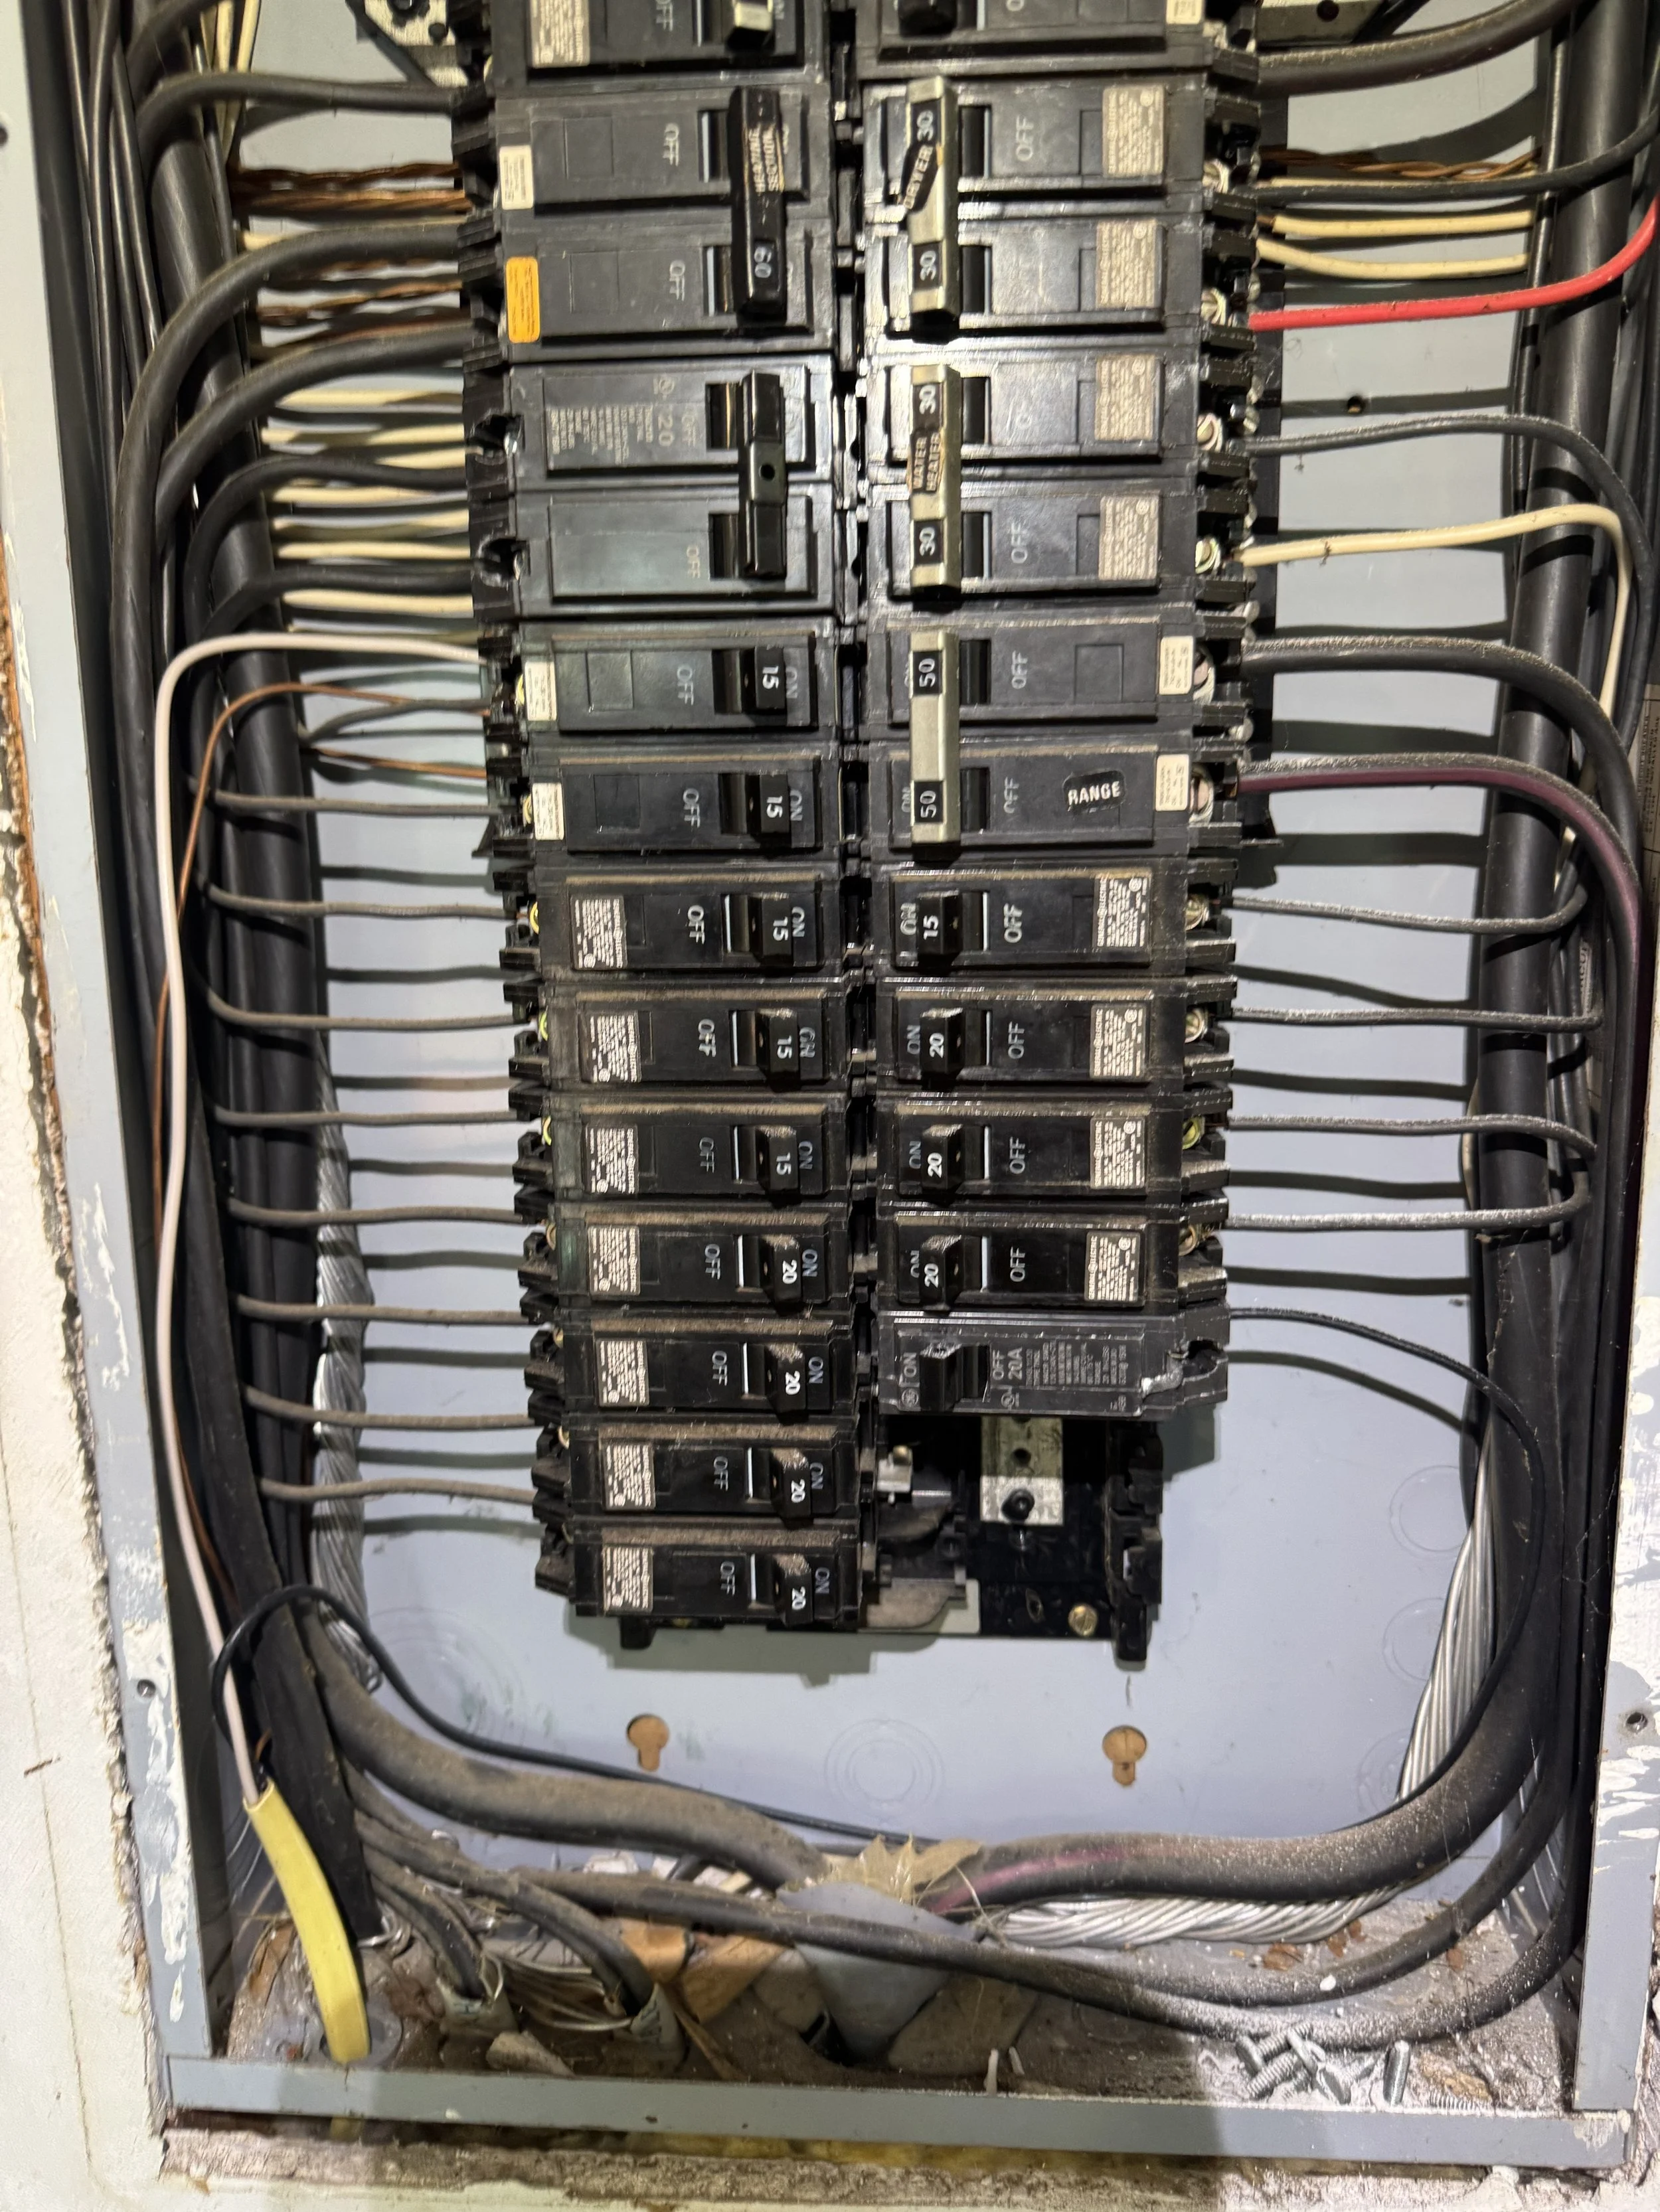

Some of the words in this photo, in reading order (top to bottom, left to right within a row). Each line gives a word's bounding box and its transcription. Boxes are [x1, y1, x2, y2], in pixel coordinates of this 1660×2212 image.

[917, 110, 934, 139] 30
[1016, 116, 1033, 161] OFF
[663, 123, 680, 166] OFF
[904, 145, 934, 209] DRYER
[754, 246, 772, 277] 60
[920, 250, 936, 280] 30
[669, 260, 685, 301] OFF
[920, 385, 936, 414] 30
[658, 416, 675, 447] 20
[913, 436, 927, 489] WATER
[926, 432, 940, 491] HEATER
[920, 527, 936, 556] 30
[1011, 522, 1028, 564] OFF
[687, 546, 700, 578] OFF
[762, 666, 780, 690] 15
[919, 658, 935, 686] 50
[1011, 651, 1028, 689] OFF
[677, 667, 694, 706] OFF
[683, 788, 701, 828] OFF
[766, 796, 784, 819] 15
[790, 790, 803, 821] ON
[921, 790, 937, 817] 50
[1005, 777, 1019, 813] OFF
[1068, 781, 1121, 805] RANGE
[688, 905, 705, 945] OFF
[773, 917, 789, 941] 15
[791, 907, 805, 937] ON
[900, 903, 916, 936] ON
[923, 915, 939, 938] 15
[1004, 904, 1023, 943] OFF
[698, 1019, 716, 1057] OFF
[777, 1035, 793, 1059] 15
[799, 1027, 815, 1058] ON
[907, 1025, 920, 1054] ON
[930, 1032, 944, 1058] 20
[1008, 1022, 1025, 1059] OFF
[699, 1137, 714, 1173] OFF
[776, 1152, 791, 1176] 15
[798, 1140, 813, 1170] ON
[908, 1141, 921, 1169] ON
[928, 1152, 942, 1178] 20
[1009, 1137, 1026, 1174] OFF
[705, 1243, 720, 1280] OFF
[782, 1260, 797, 1284] 20
[801, 1249, 818, 1277] ON
[924, 1263, 939, 1288] 20
[1010, 1246, 1026, 1283] OFF
[712, 1350, 728, 1386] OFF
[808, 1356, 824, 1384] ON
[903, 1352, 917, 1378] ON
[993, 1349, 1005, 1380] OFF
[1007, 1346, 1023, 1380] 20A
[785, 1370, 801, 1395] 20
[714, 1456, 728, 1491] OFF
[809, 1462, 824, 1490] ON
[791, 1478, 805, 1503] 20
[720, 1561, 735, 1596] OFF
[815, 1567, 830, 1594] ON
[791, 1586, 806, 1611] 20
